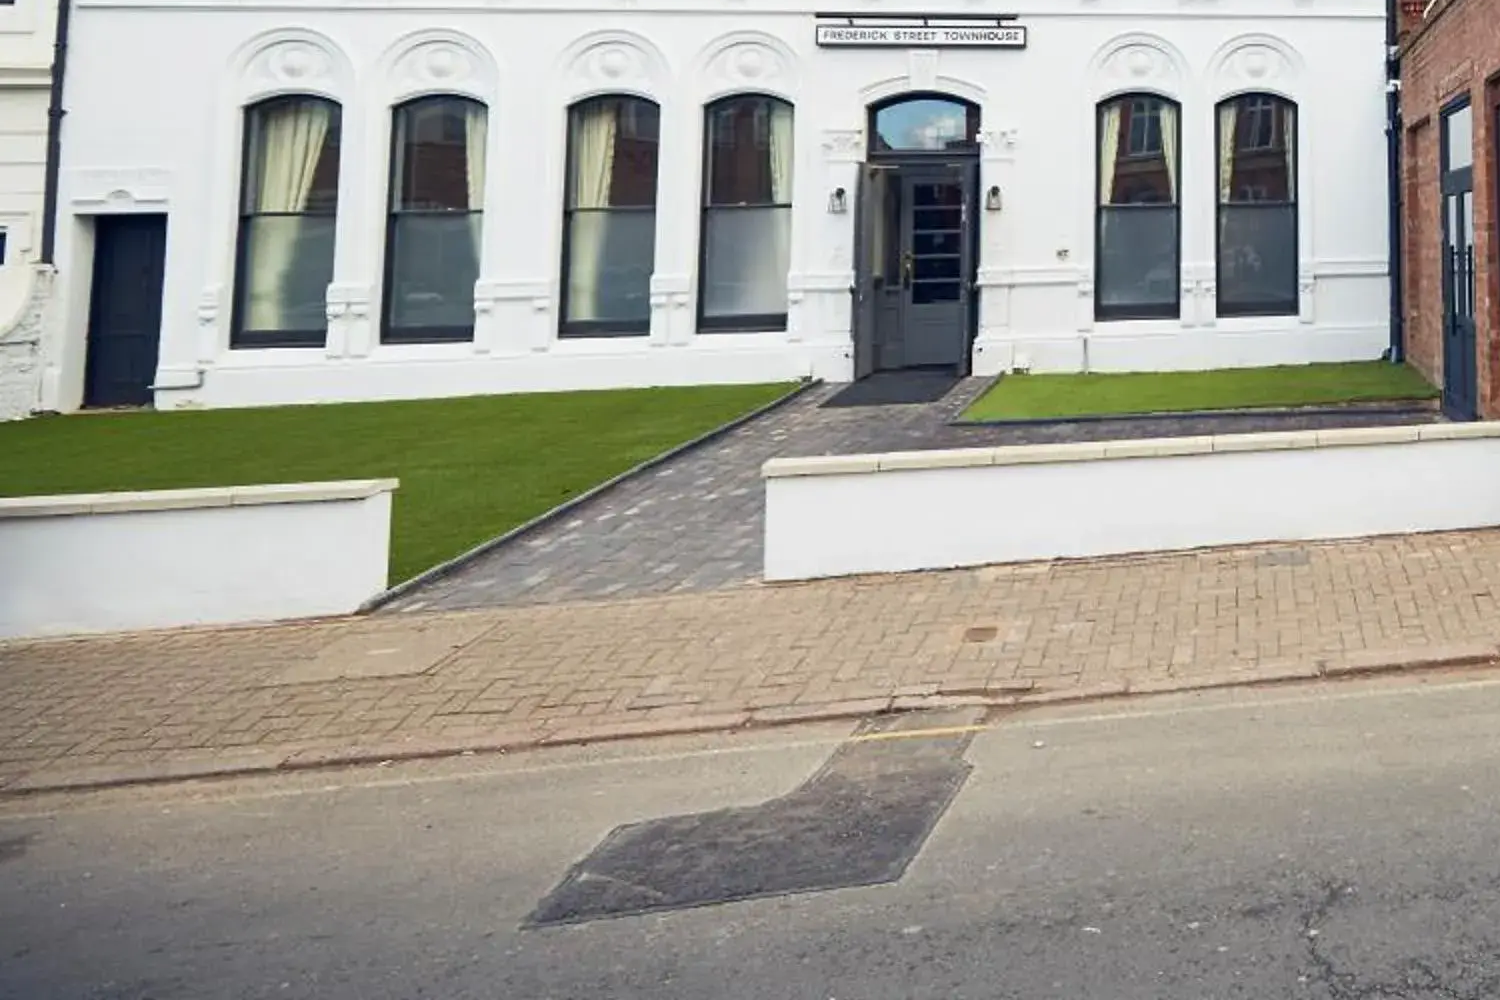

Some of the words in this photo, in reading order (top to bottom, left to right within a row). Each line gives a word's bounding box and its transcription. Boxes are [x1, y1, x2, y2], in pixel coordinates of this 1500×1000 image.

[822, 29, 888, 41] FREDERICK
[894, 30, 936, 41] STREET
[943, 30, 1019, 42] TOWNHOUSE
